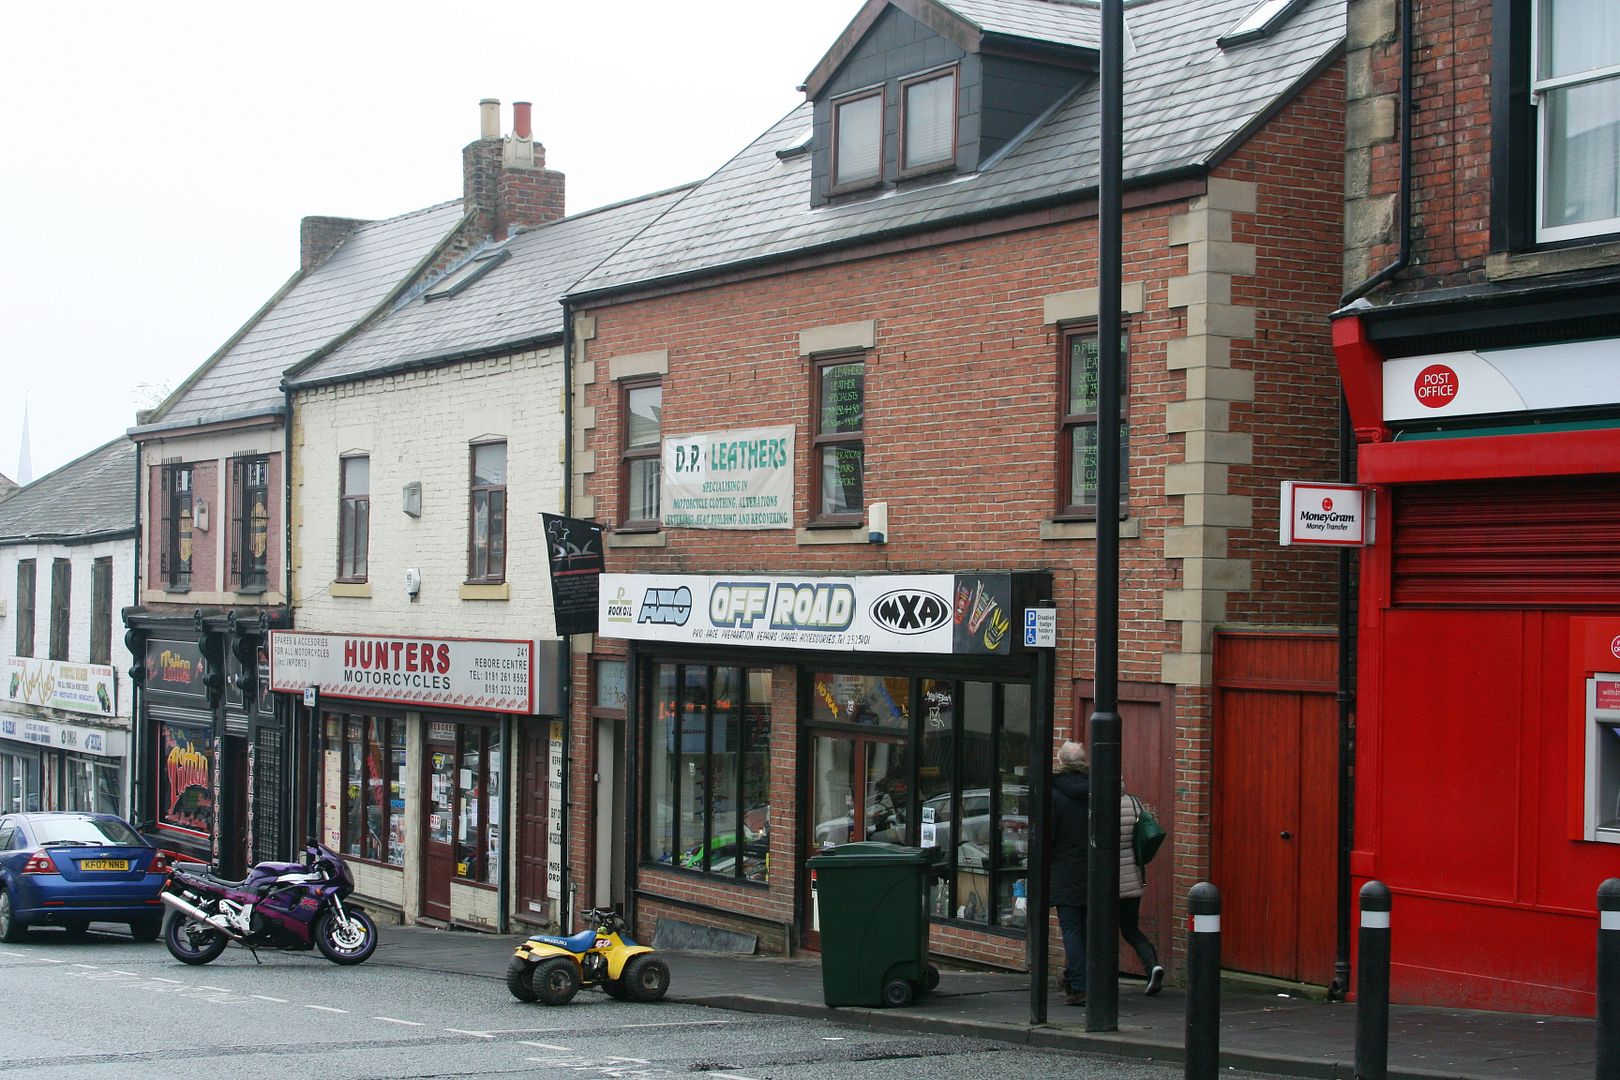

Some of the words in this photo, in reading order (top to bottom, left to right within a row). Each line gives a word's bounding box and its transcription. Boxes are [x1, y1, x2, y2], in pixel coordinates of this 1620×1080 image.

[1424, 372, 1450, 385] POST
[1418, 384, 1454, 398] OFFICE
[711, 438, 787, 472] LEATHERS
[702, 480, 740, 493] SPECIALISING
[742, 480, 748, 491] IN
[672, 498, 708, 510] MOTORCYCLE
[738, 496, 778, 508] ALTERATIONS
[710, 514, 737, 525] BUILDING
[738, 513, 750, 524] AND
[750, 512, 788, 524] RECOVERING
[1300, 511, 1355, 523] MoneyGram
[1306, 523, 1325, 531] Money
[608, 606, 622, 616] ROCK
[637, 586, 692, 626] AXO
[709, 581, 771, 628] OFF
[770, 582, 855, 632] ROAD
[880, 595, 939, 630] MXA
[1028, 612, 1035, 625] P
[274, 636, 292, 645] SPARES
[722, 630, 754, 640] PREPARATION
[756, 630, 778, 641] REPAIRS
[274, 646, 284, 655] FOR
[285, 648, 293, 656] ALL
[294, 648, 330, 658] MOTORCYCLES
[344, 640, 450, 674] HUNTERS
[517, 648, 528, 656] 241
[475, 658, 500, 668] REBORE
[502, 660, 527, 670] CENTRE
[344, 670, 450, 690] MOTORCYCLES
[470, 670, 482, 680] TEL:
[485, 671, 498, 680] 0191
[500, 672, 510, 682] 261
[513, 673, 527, 683] 8592
[485, 684, 498, 694] 0191
[500, 684, 510, 694] 232
[513, 686, 527, 696] 1298
[85, 860, 106, 868] KF07
[108, 860, 125, 869] NNB
[549, 862, 560, 872] MADE
